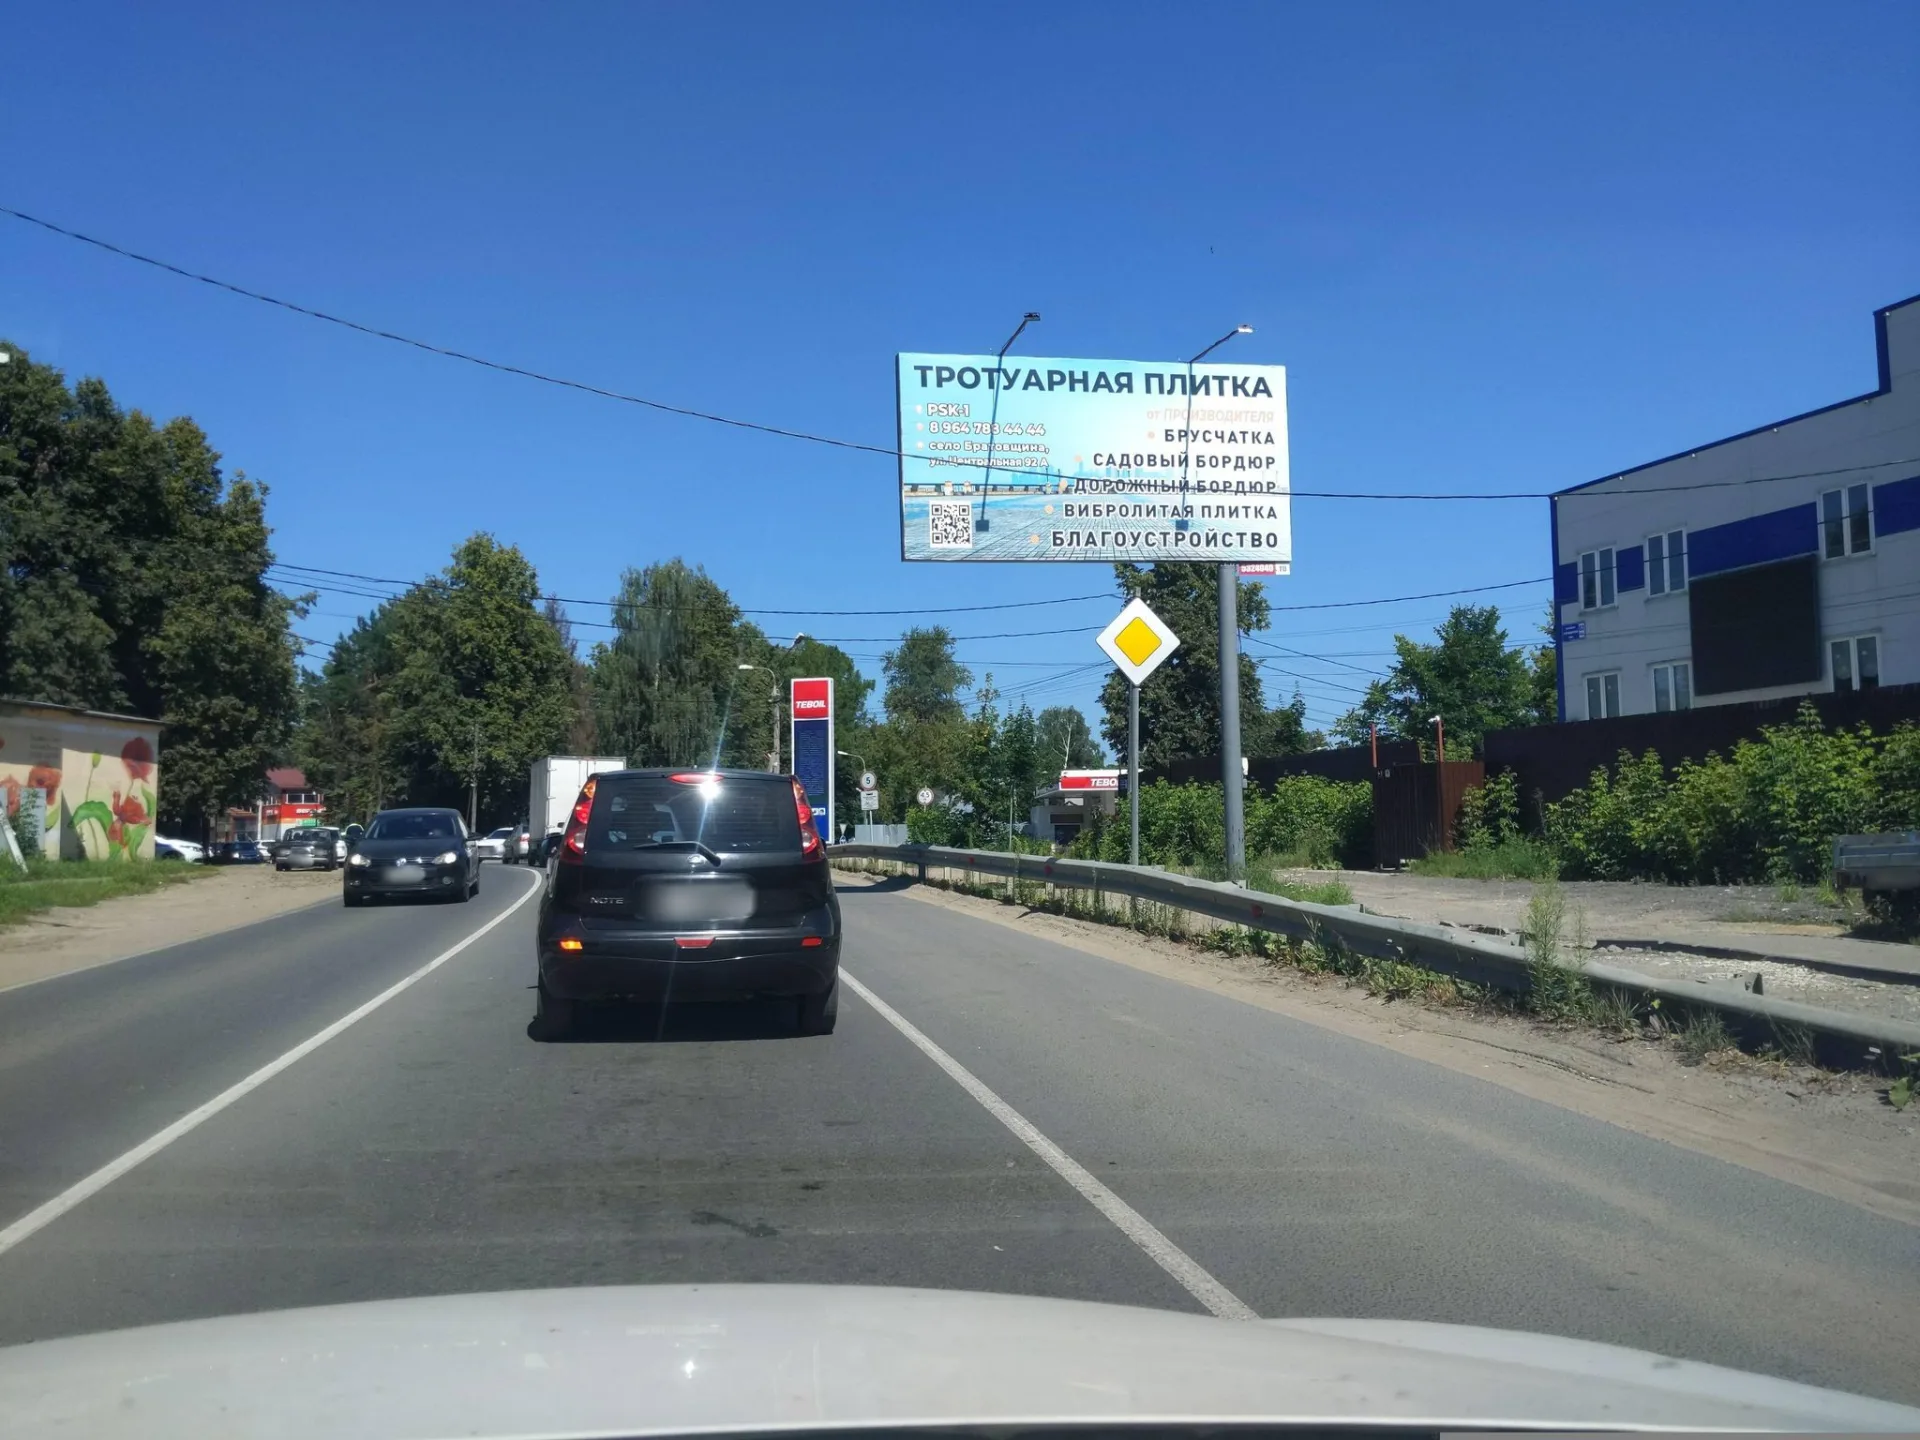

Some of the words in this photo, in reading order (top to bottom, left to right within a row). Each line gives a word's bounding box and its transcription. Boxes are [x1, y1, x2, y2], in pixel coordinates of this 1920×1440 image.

[914, 365, 1133, 394] ТРОТУАРНАЯ
[1145, 373, 1273, 398] ПЛИТКА
[927, 403, 970, 417] PSK-1
[929, 421, 939, 433] 8
[942, 422, 970, 434] 964
[1003, 423, 1023, 435] 44
[1026, 424, 1046, 435] 44
[1165, 429, 1275, 444] БРУСЧАТКА
[929, 442, 961, 450] село
[1024, 457, 1038, 466] 92
[1093, 452, 1189, 469] САДОВЫЙ
[1196, 455, 1275, 471] БОРДЮР
[1074, 477, 1189, 494] ДОРОЖНЫЙ
[1197, 480, 1276, 495] БОРДЮР
[1065, 504, 1194, 518] ВИБРОЛИТАЯ
[1201, 505, 1277, 519] ПЛИТКА
[1052, 529, 1278, 548] БЛАГОУСТРОЙСТВО
[795, 700, 826, 709] TEBOIL
[866, 776, 871, 785] 5
[1090, 778, 1118, 787] TEBO
